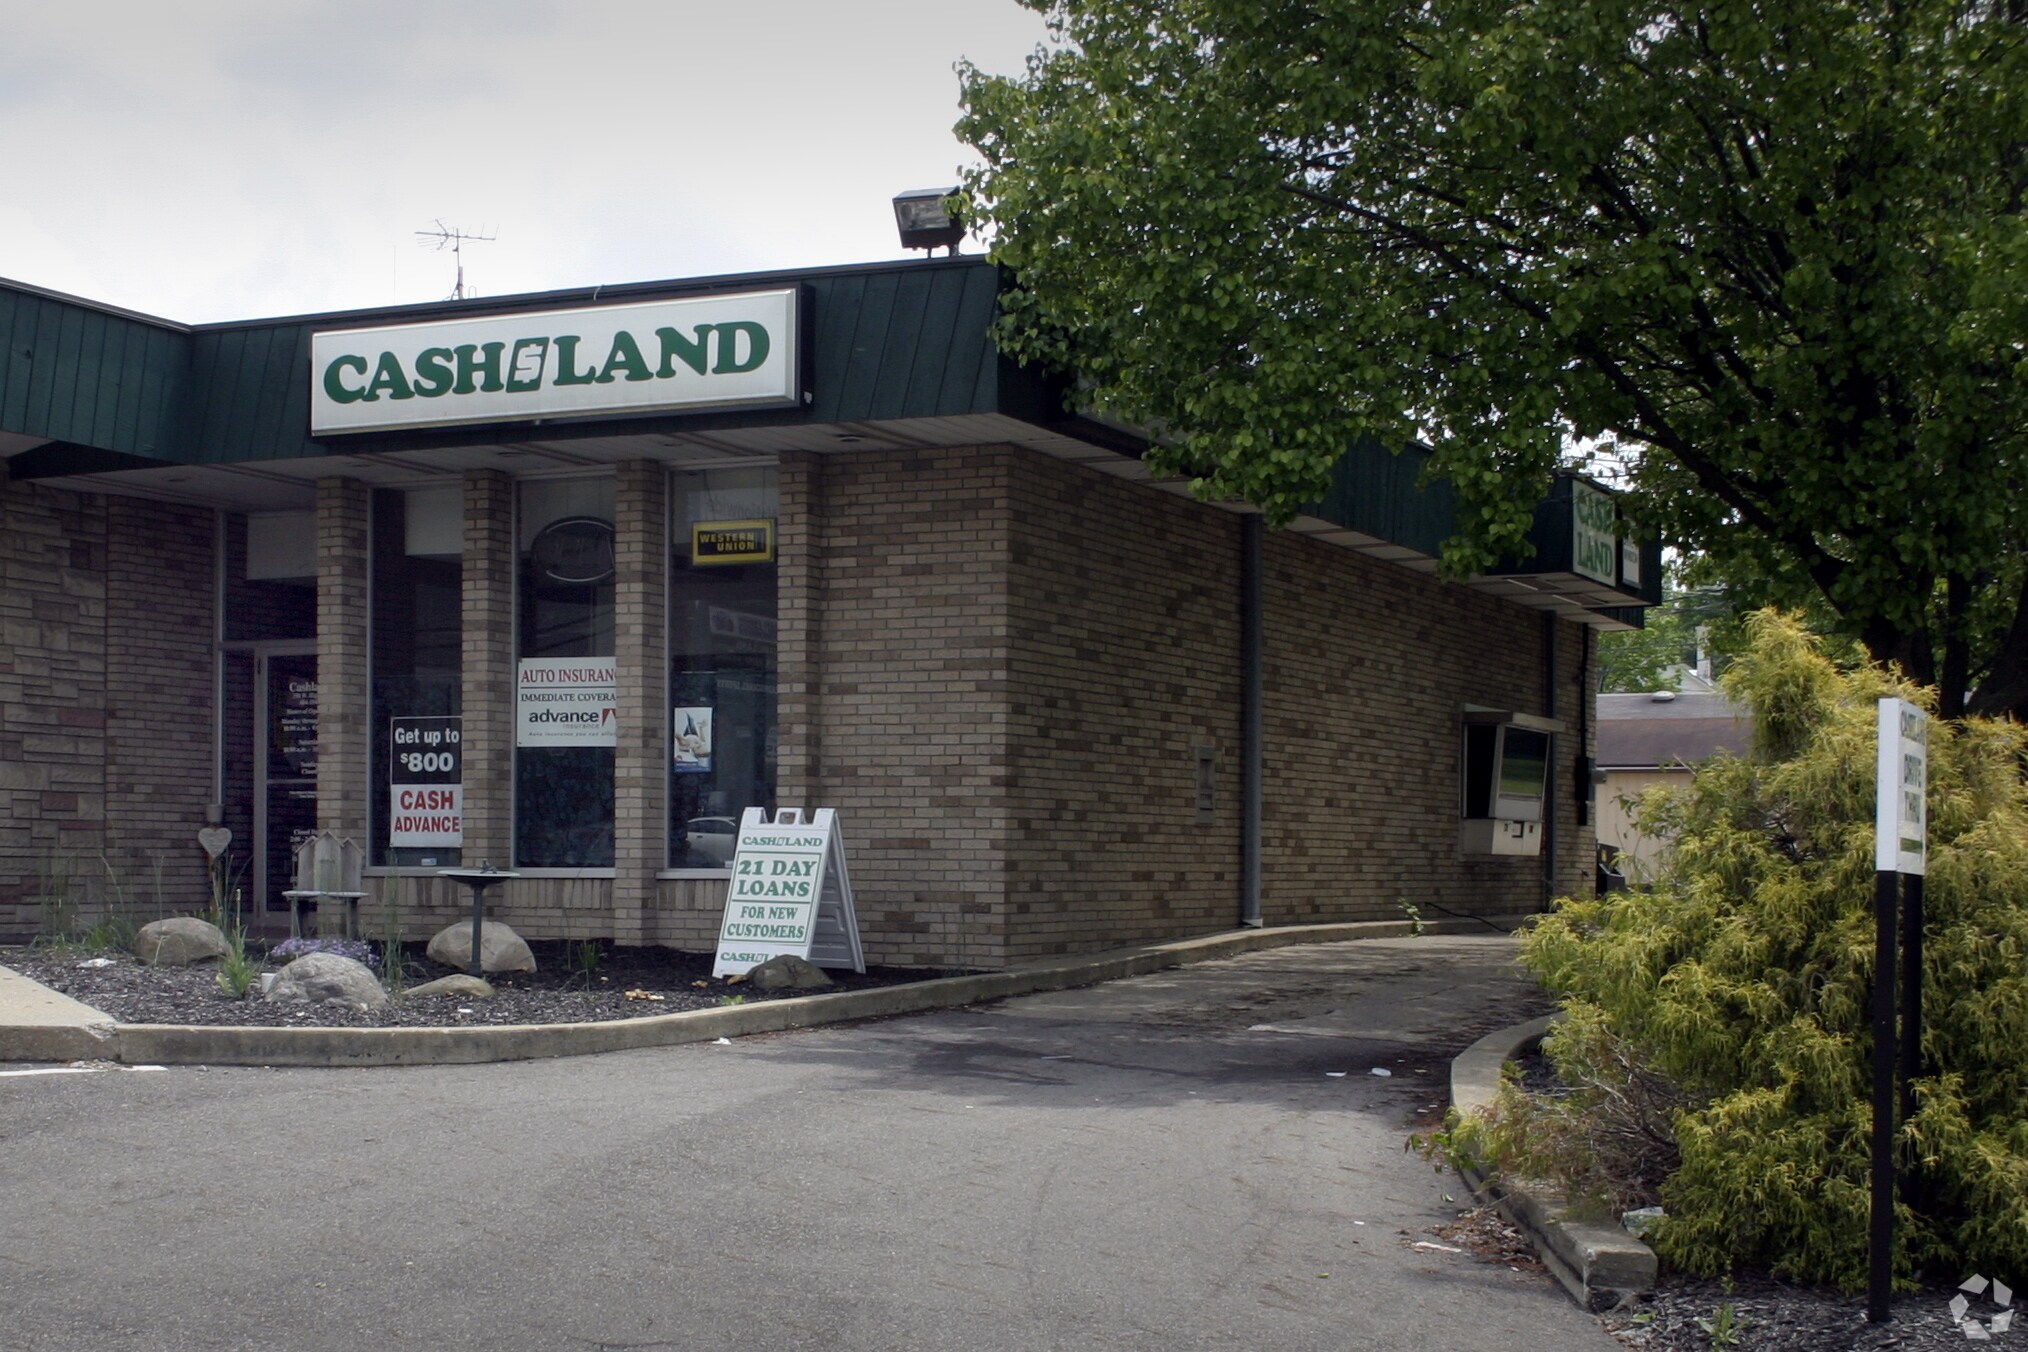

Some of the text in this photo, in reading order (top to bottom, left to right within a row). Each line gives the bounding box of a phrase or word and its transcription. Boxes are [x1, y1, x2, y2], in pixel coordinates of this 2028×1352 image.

[700, 531, 755, 543] WESTERN
[717, 540, 755, 552] UNION
[1577, 531, 1613, 578] LAND
[521, 668, 616, 683] AUTO INSURAN
[520, 693, 575, 702] IMMEDIATE
[529, 708, 600, 723] advance
[395, 727, 460, 747] Get up to
[400, 752, 454, 772] $800
[400, 790, 454, 810] CASH
[394, 815, 460, 832] ADVANCE
[738, 860, 817, 876] 21 DAY
[737, 880, 810, 897] LOANS
[740, 906, 798, 920] FOR NEW
[727, 923, 804, 939] CUSTOMERS
